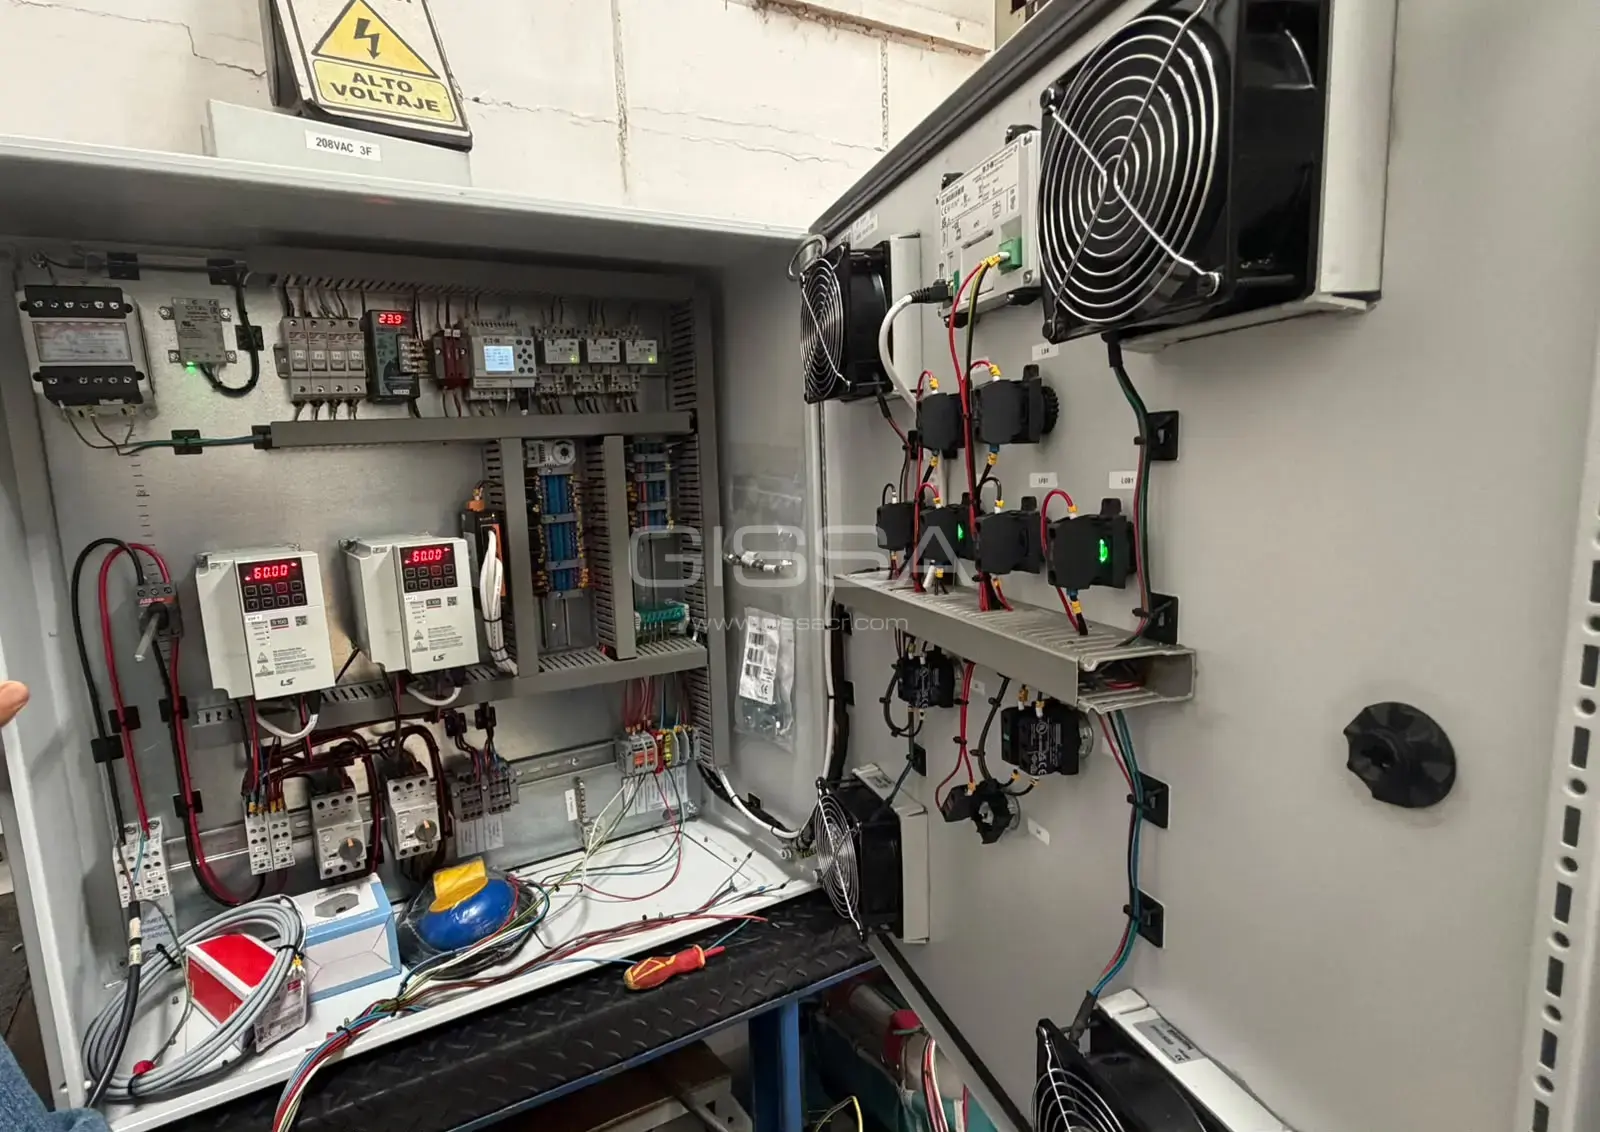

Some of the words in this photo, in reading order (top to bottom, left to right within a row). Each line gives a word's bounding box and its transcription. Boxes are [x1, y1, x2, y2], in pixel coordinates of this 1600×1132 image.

[352, 72, 413, 92] ALTO
[331, 82, 441, 112] VOLTAJE
[315, 136, 354, 154] 208VAC
[359, 146, 373, 157] 3F
[413, 548, 442, 562] 60.00
[253, 564, 288, 580] 60.00
[433, 653, 447, 662] LS
[280, 677, 296, 687] LS
